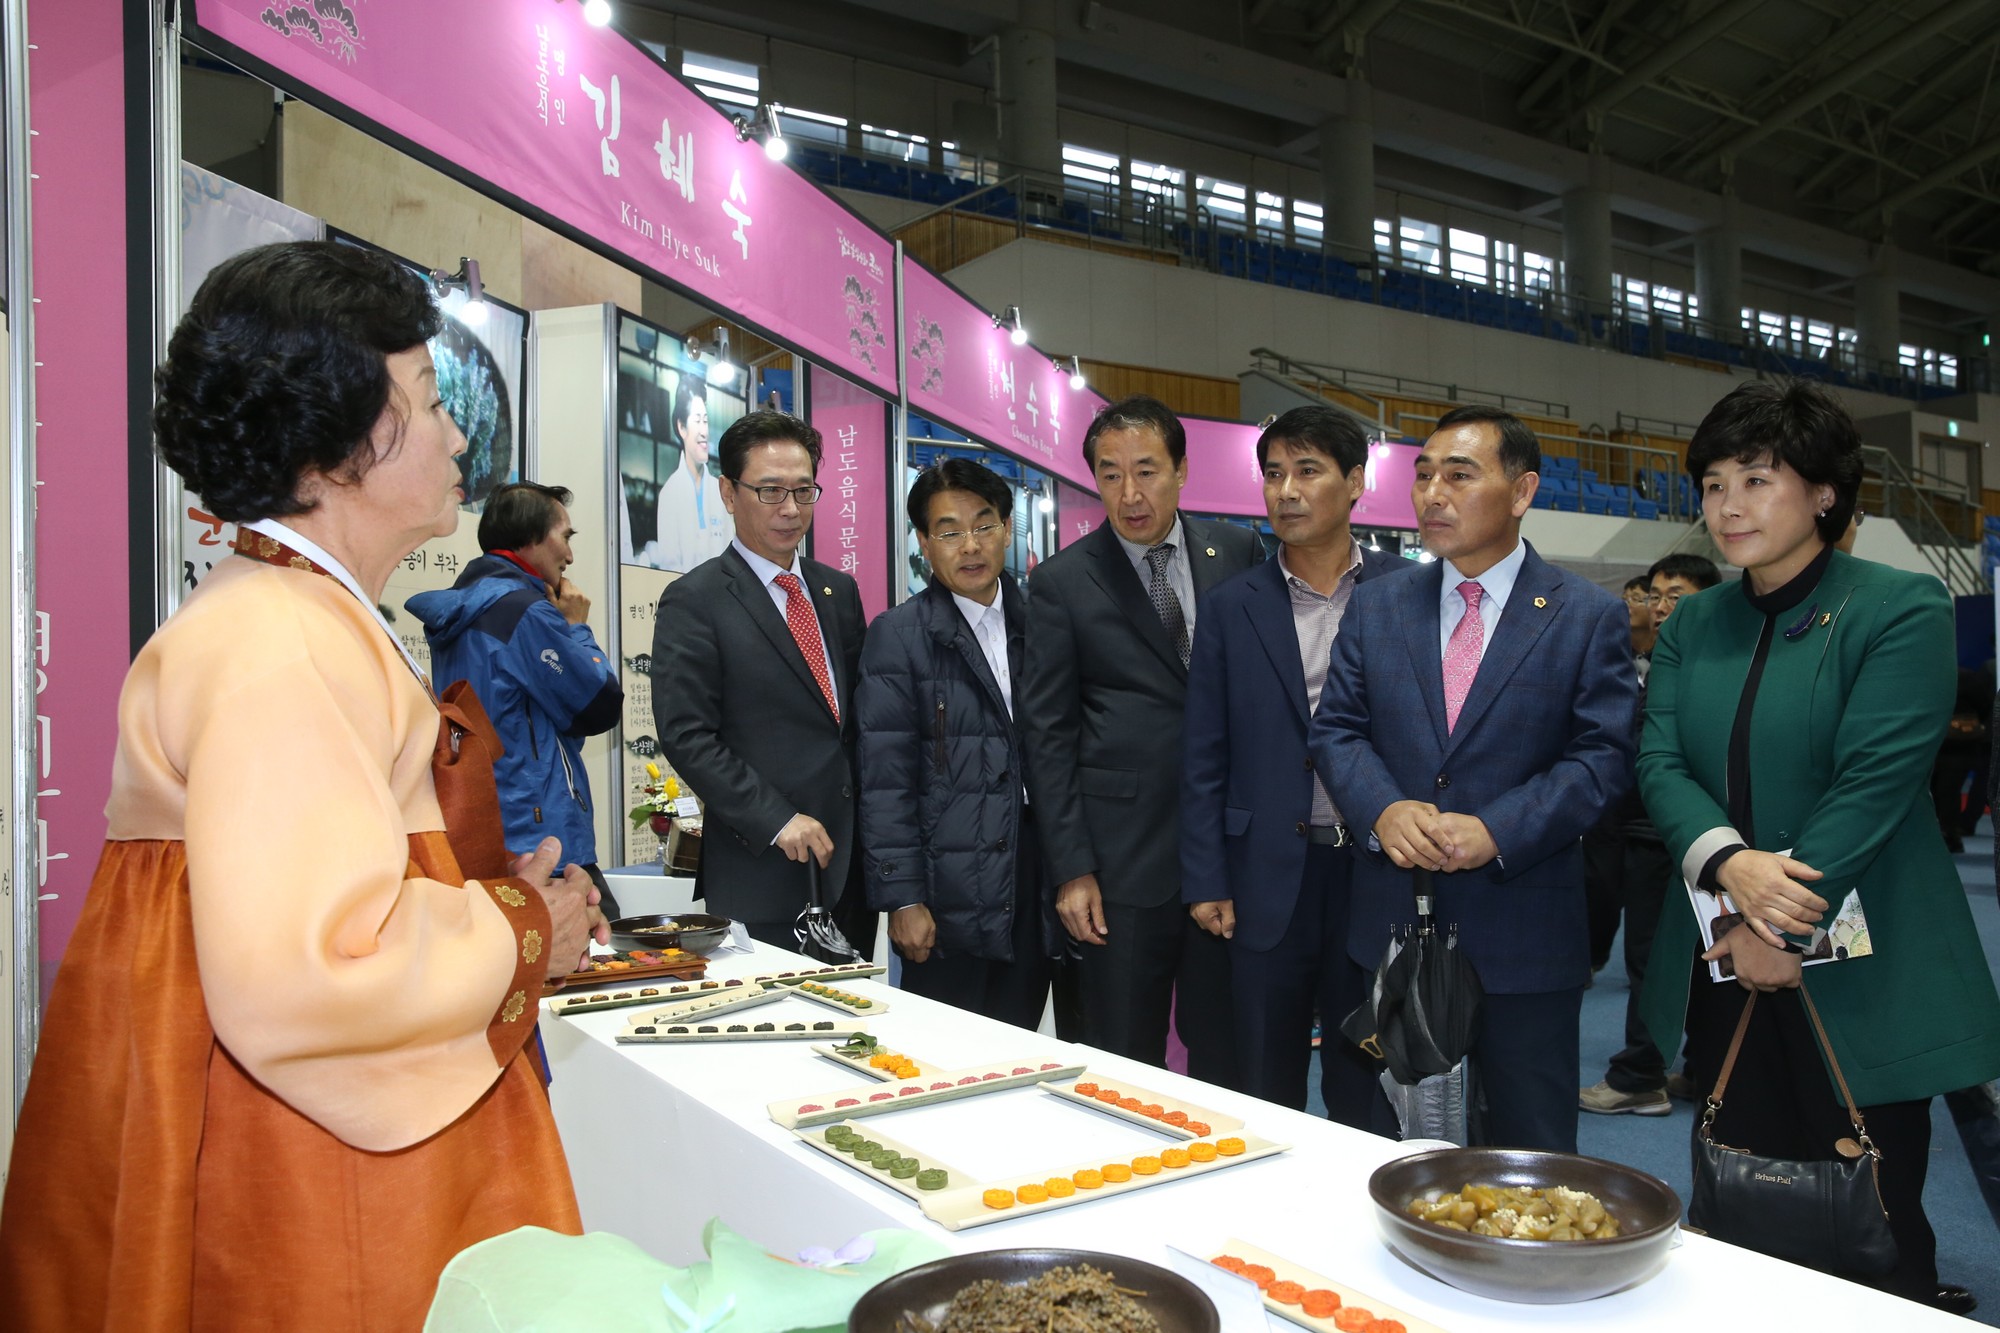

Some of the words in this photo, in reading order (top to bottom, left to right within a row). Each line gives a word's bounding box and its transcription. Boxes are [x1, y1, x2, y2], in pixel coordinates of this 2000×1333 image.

[536, 24, 550, 126] 남도음식
[553, 48, 566, 126] 명인
[579, 73, 752, 261] 김혜숙
[620, 201, 654, 239] Kim
[661, 225, 690, 261] Hye
[695, 247, 721, 278] Suk
[837, 424, 860, 574] 남도음식문화
[433, 553, 459, 575] 부각
[629, 604, 645, 620] 명인
